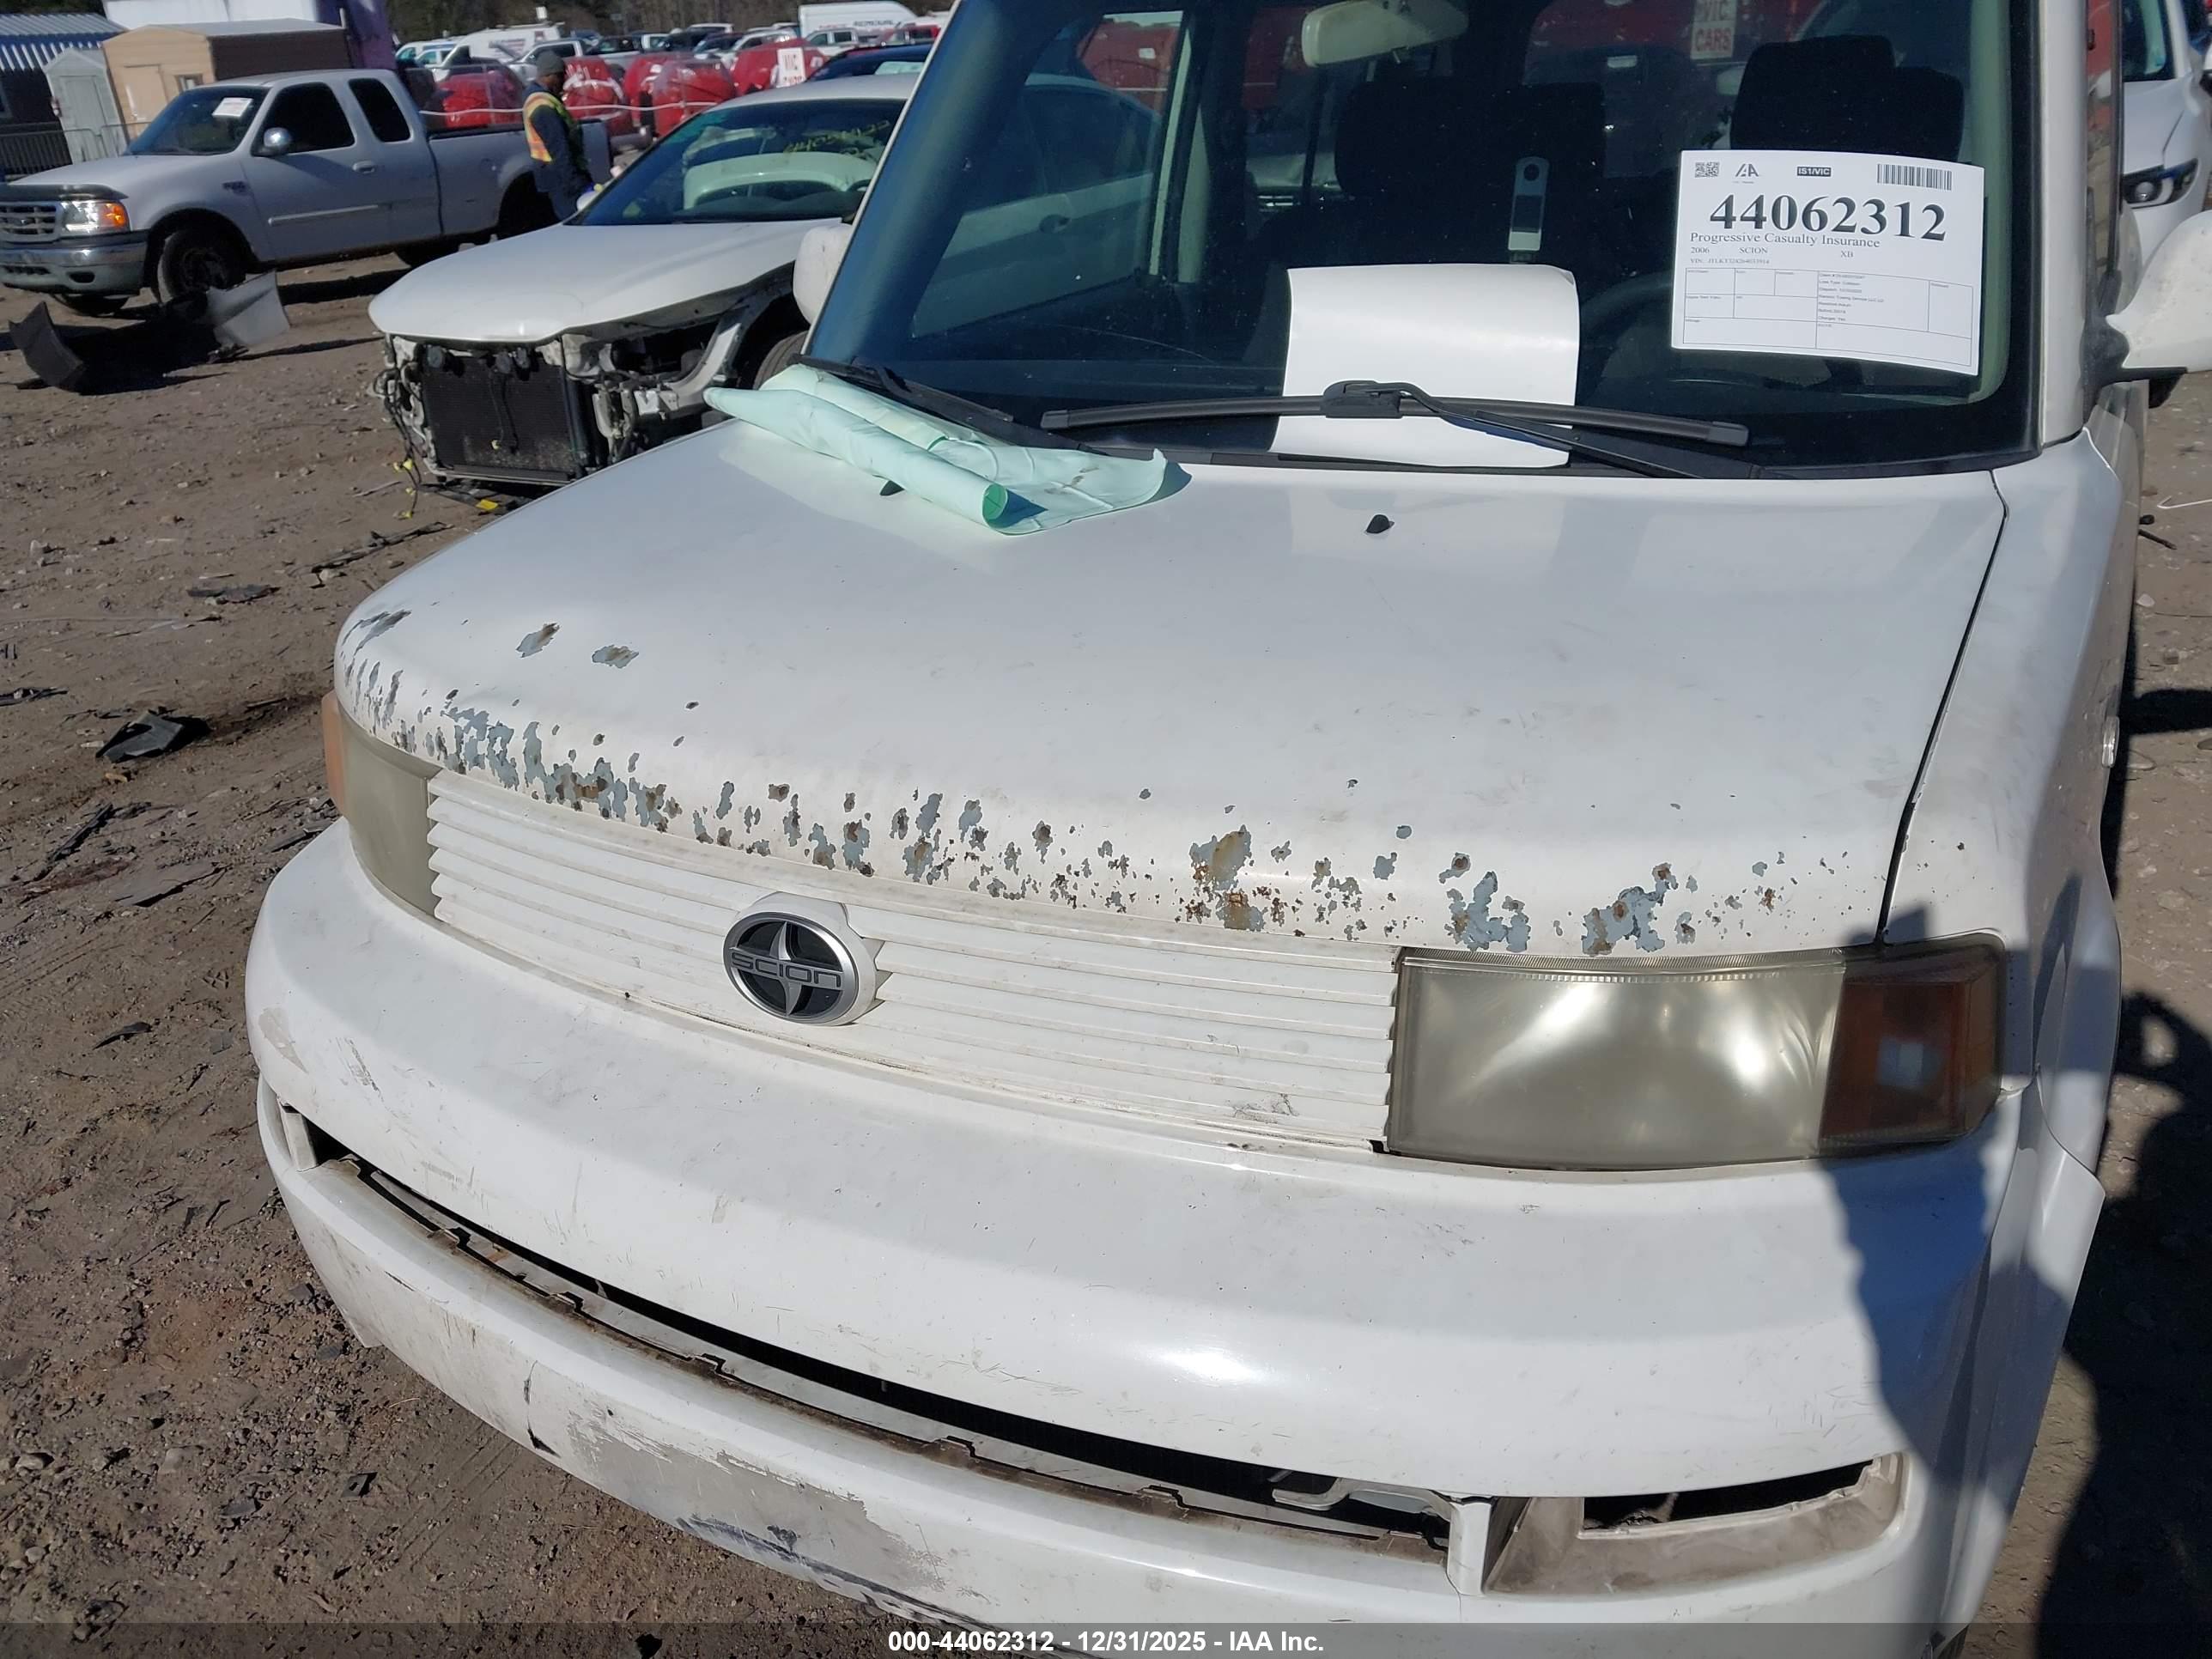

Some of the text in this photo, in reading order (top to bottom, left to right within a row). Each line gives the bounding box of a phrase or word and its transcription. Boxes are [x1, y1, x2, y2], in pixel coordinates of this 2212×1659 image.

[1710, 194, 1947, 241] 44062312
[1690, 232, 1880, 248] Progressive Casualty Insurance
[1840, 250, 1854, 258] XB
[731, 951, 842, 988] SCION
